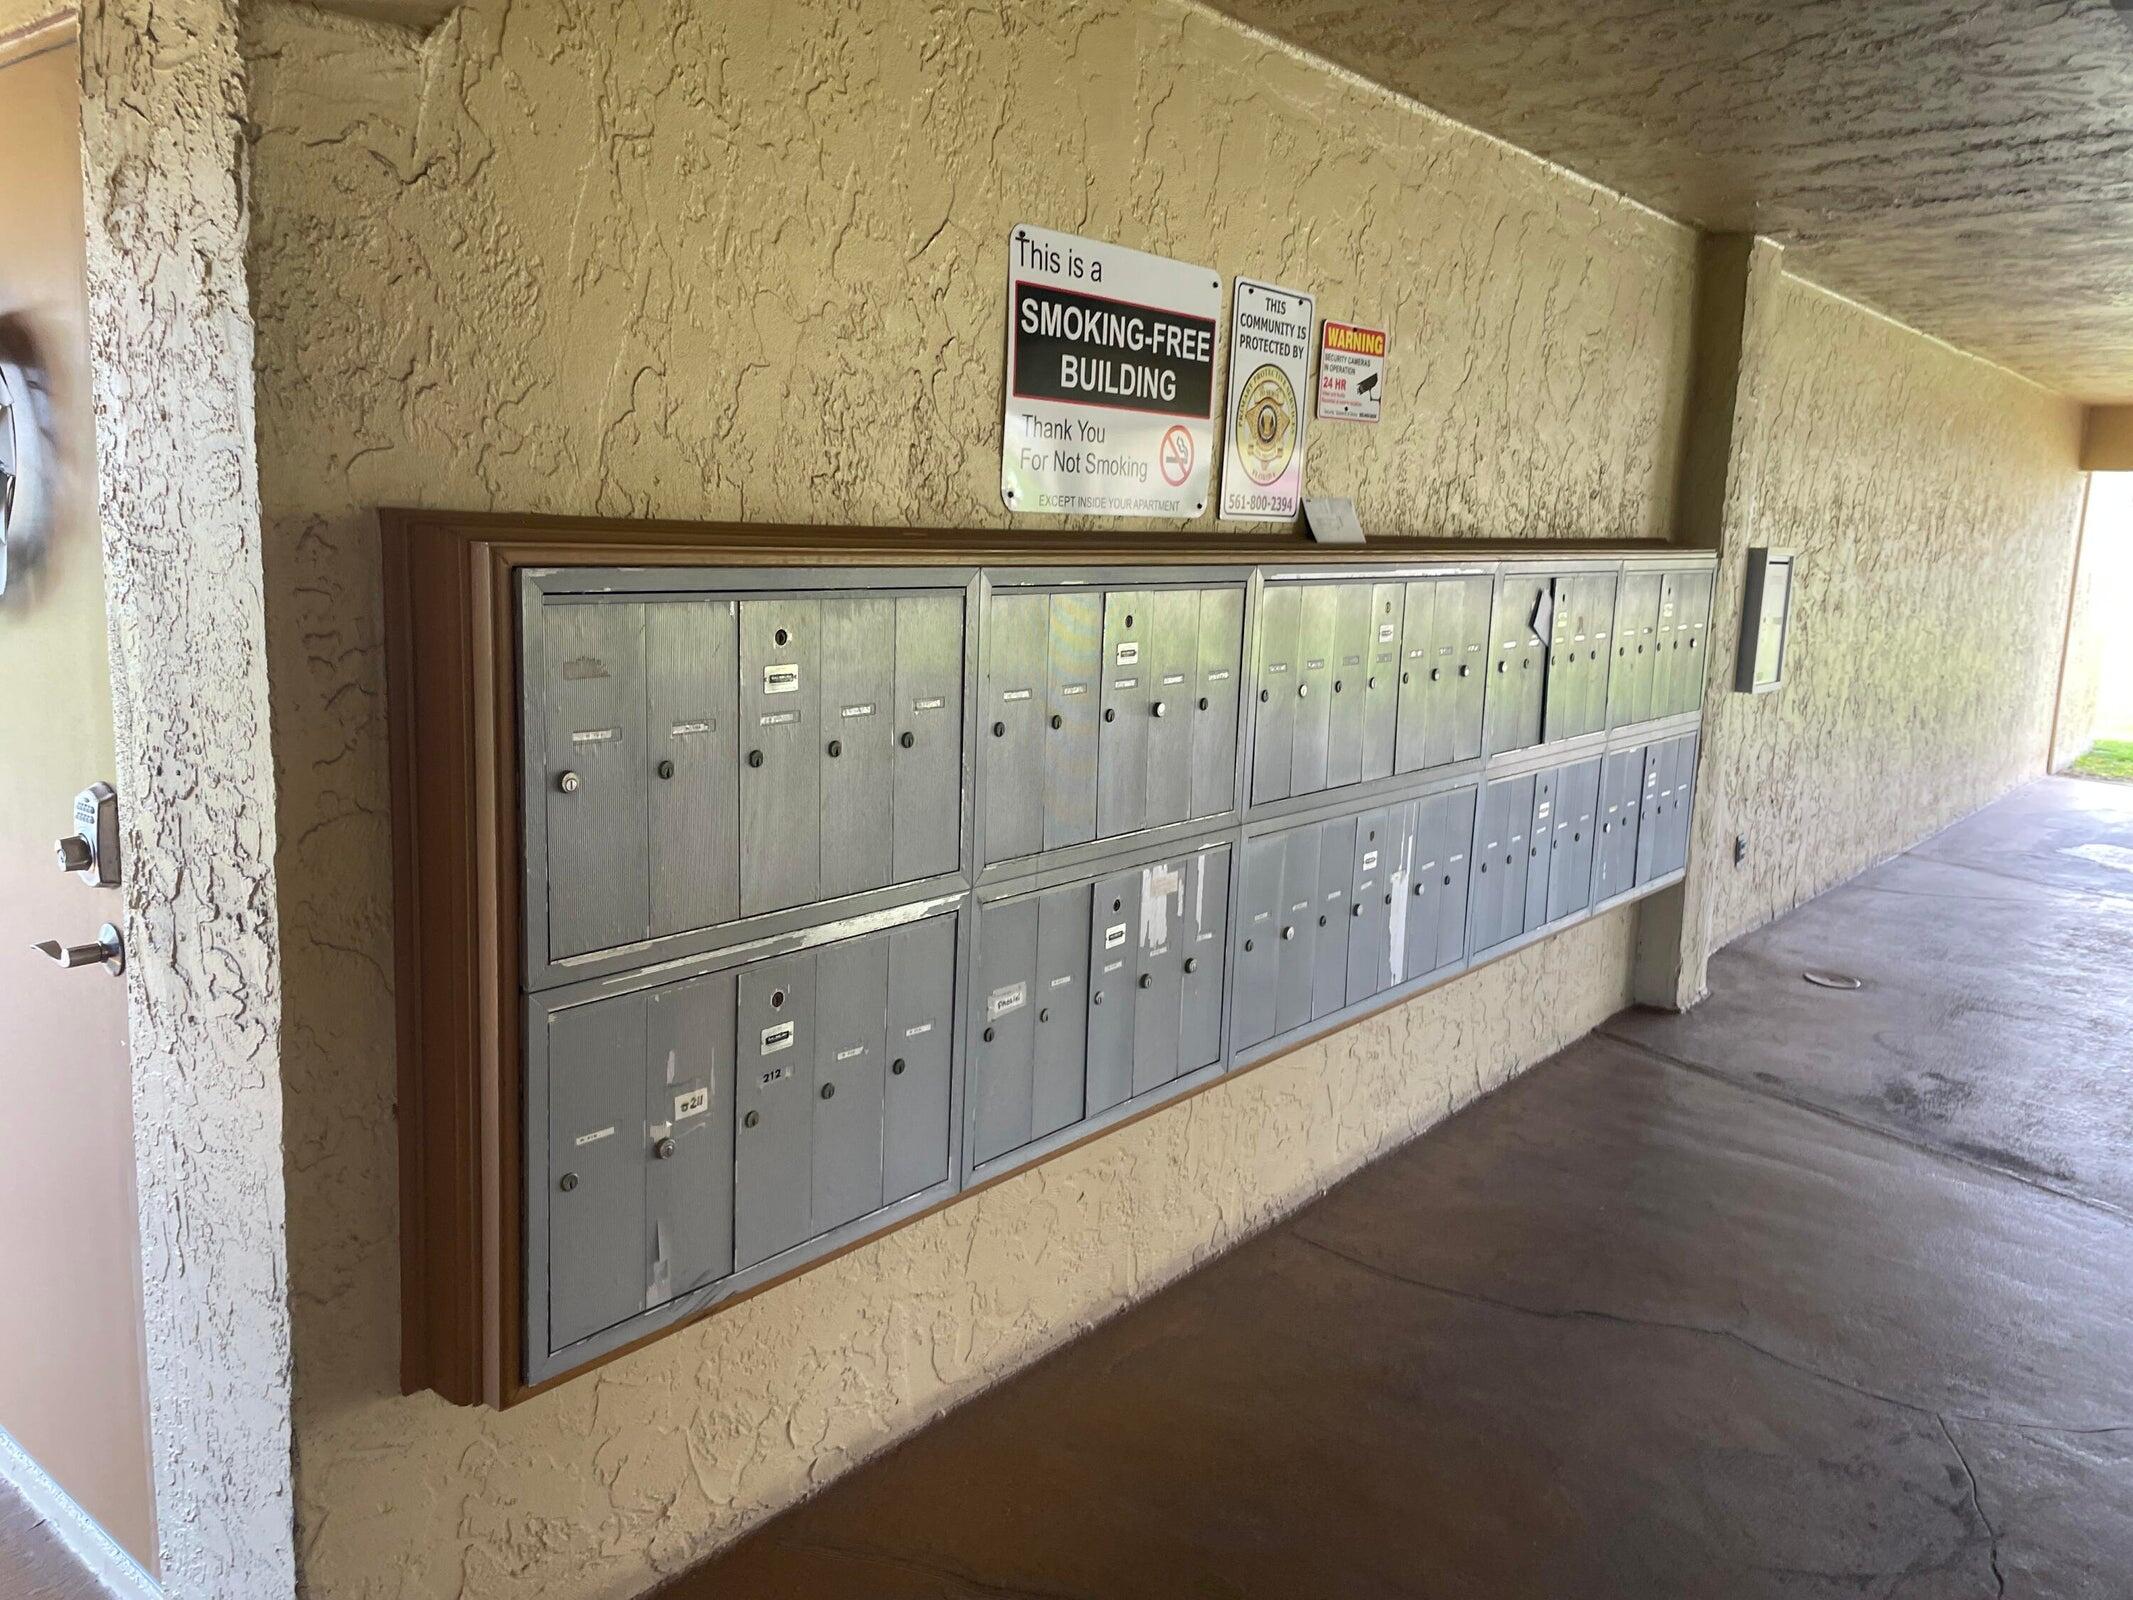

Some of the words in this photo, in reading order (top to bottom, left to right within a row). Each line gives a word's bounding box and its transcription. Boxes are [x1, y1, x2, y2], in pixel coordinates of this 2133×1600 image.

[1015, 235, 1060, 273] This
[1068, 248, 1084, 278] is
[1090, 261, 1102, 282] a
[1265, 297, 1286, 315] THIS
[1020, 297, 1211, 363] SMOKING-FREE
[1239, 312, 1295, 338] COMMUNITY
[1296, 325, 1307, 340] IS
[1239, 336, 1291, 357] PROTECTED
[1292, 343, 1305, 360] BY
[1327, 326, 1384, 355] WARNING
[1324, 353, 1347, 364] SECURITY
[1347, 355, 1371, 368] CAMERAS
[1329, 364, 1356, 375] OPERATION
[1060, 354, 1177, 402] BUILDING
[1253, 368, 1286, 386] PROTECTIVE
[1323, 376, 1333, 389] 24
[1335, 378, 1347, 391] HR
[1021, 414, 1073, 442] Thank
[1077, 420, 1106, 444] You
[1020, 447, 1048, 471] For
[1053, 450, 1081, 473] Not
[1085, 452, 1148, 483] Smoking
[1038, 494, 1076, 508] EXCEPT
[1077, 496, 1106, 509] INSIDE
[1108, 497, 1132, 510] YOUR
[1133, 499, 1181, 512] APARTMENT
[1228, 492, 1293, 512] 561-800-2394
[762, 1068, 782, 1083] 212
